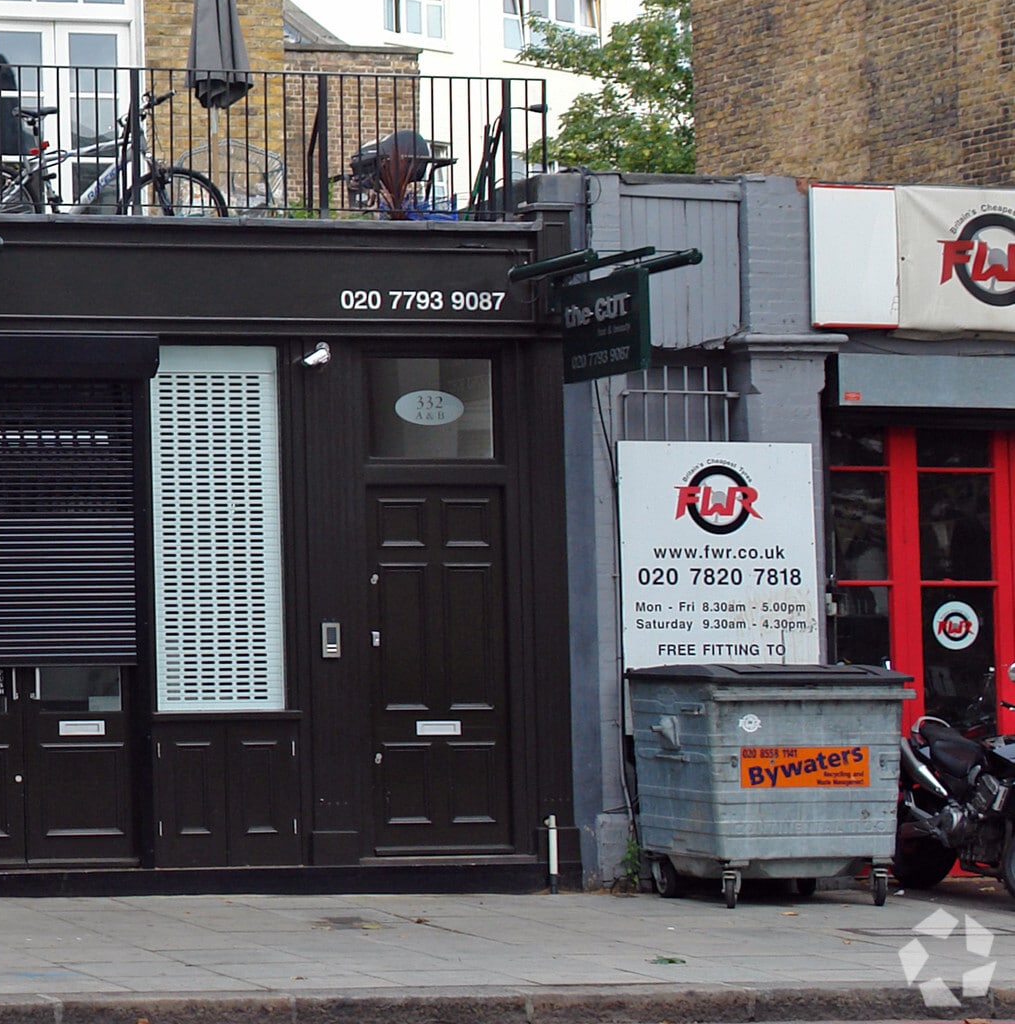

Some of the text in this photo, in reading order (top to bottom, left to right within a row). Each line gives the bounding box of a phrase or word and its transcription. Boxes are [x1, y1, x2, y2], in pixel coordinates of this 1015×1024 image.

[949, 209, 977, 235] Britain's
[937, 240, 1015, 285] FW
[341, 290, 505, 311] 020 7793 9087
[565, 292, 631, 329] the CUT
[588, 349, 609, 367] 7793
[609, 346, 630, 363] 9087
[416, 396, 444, 410] 332
[416, 411, 445, 420] A & B
[707, 459, 737, 468] Cheapest
[739, 466, 753, 483] Tyres
[674, 486, 763, 520] FWR
[653, 545, 785, 559] www.fwr.co.uk
[638, 568, 802, 586] 020 7820 7818
[635, 601, 662, 612] Mon
[679, 601, 695, 612] Fri
[702, 601, 746, 612] 8.30am
[762, 601, 806, 615] 5.00pm
[636, 619, 693, 631] Saturday
[702, 619, 746, 629] 9.30am
[762, 619, 807, 632] 4.30pm
[937, 620, 975, 635] FWR
[658, 644, 786, 656] FREE FITTING TO
[742, 748, 756, 759] 020
[748, 747, 863, 787] Bywaters
